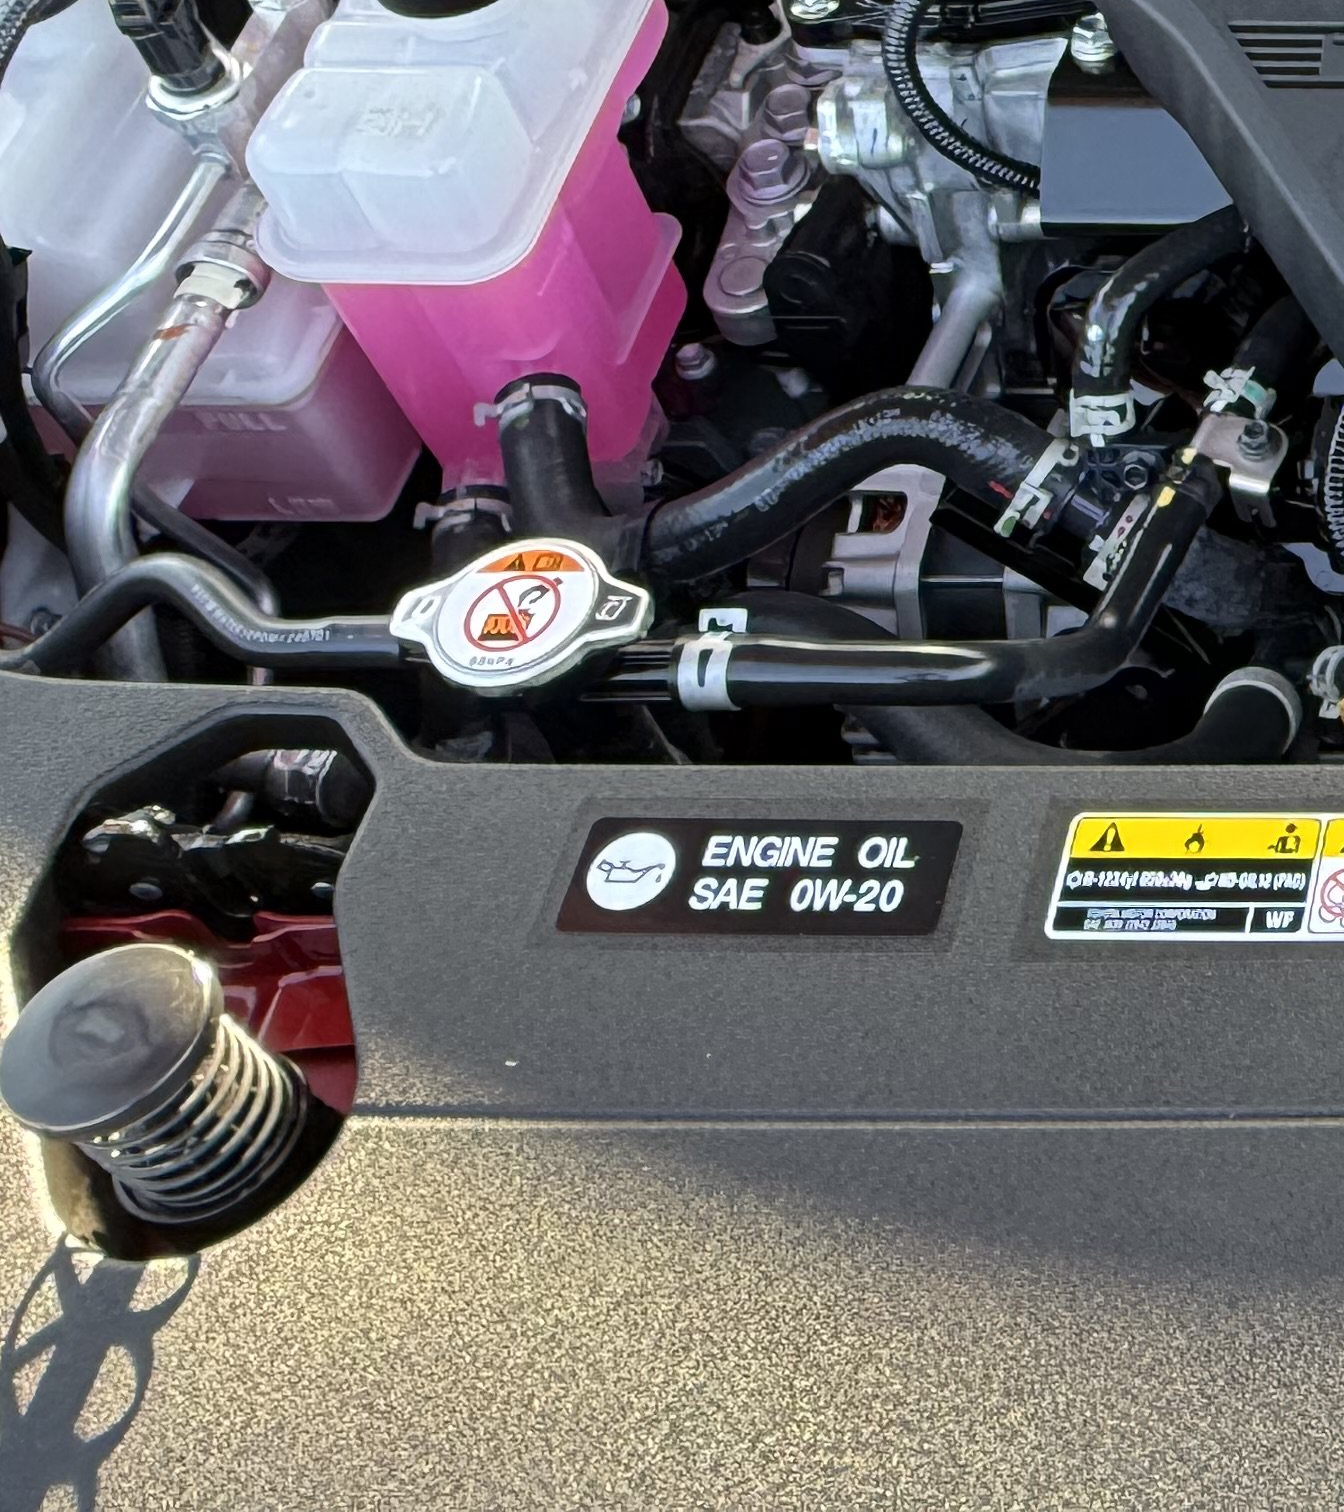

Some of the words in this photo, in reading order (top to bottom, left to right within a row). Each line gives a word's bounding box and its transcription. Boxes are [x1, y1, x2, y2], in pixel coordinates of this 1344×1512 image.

[194, 412, 288, 431] FULL
[701, 834, 839, 868] ENGINE
[857, 835, 917, 869] OIL
[687, 876, 769, 911] SAE
[789, 878, 904, 912] 0W-20
[1265, 910, 1295, 929] WF
